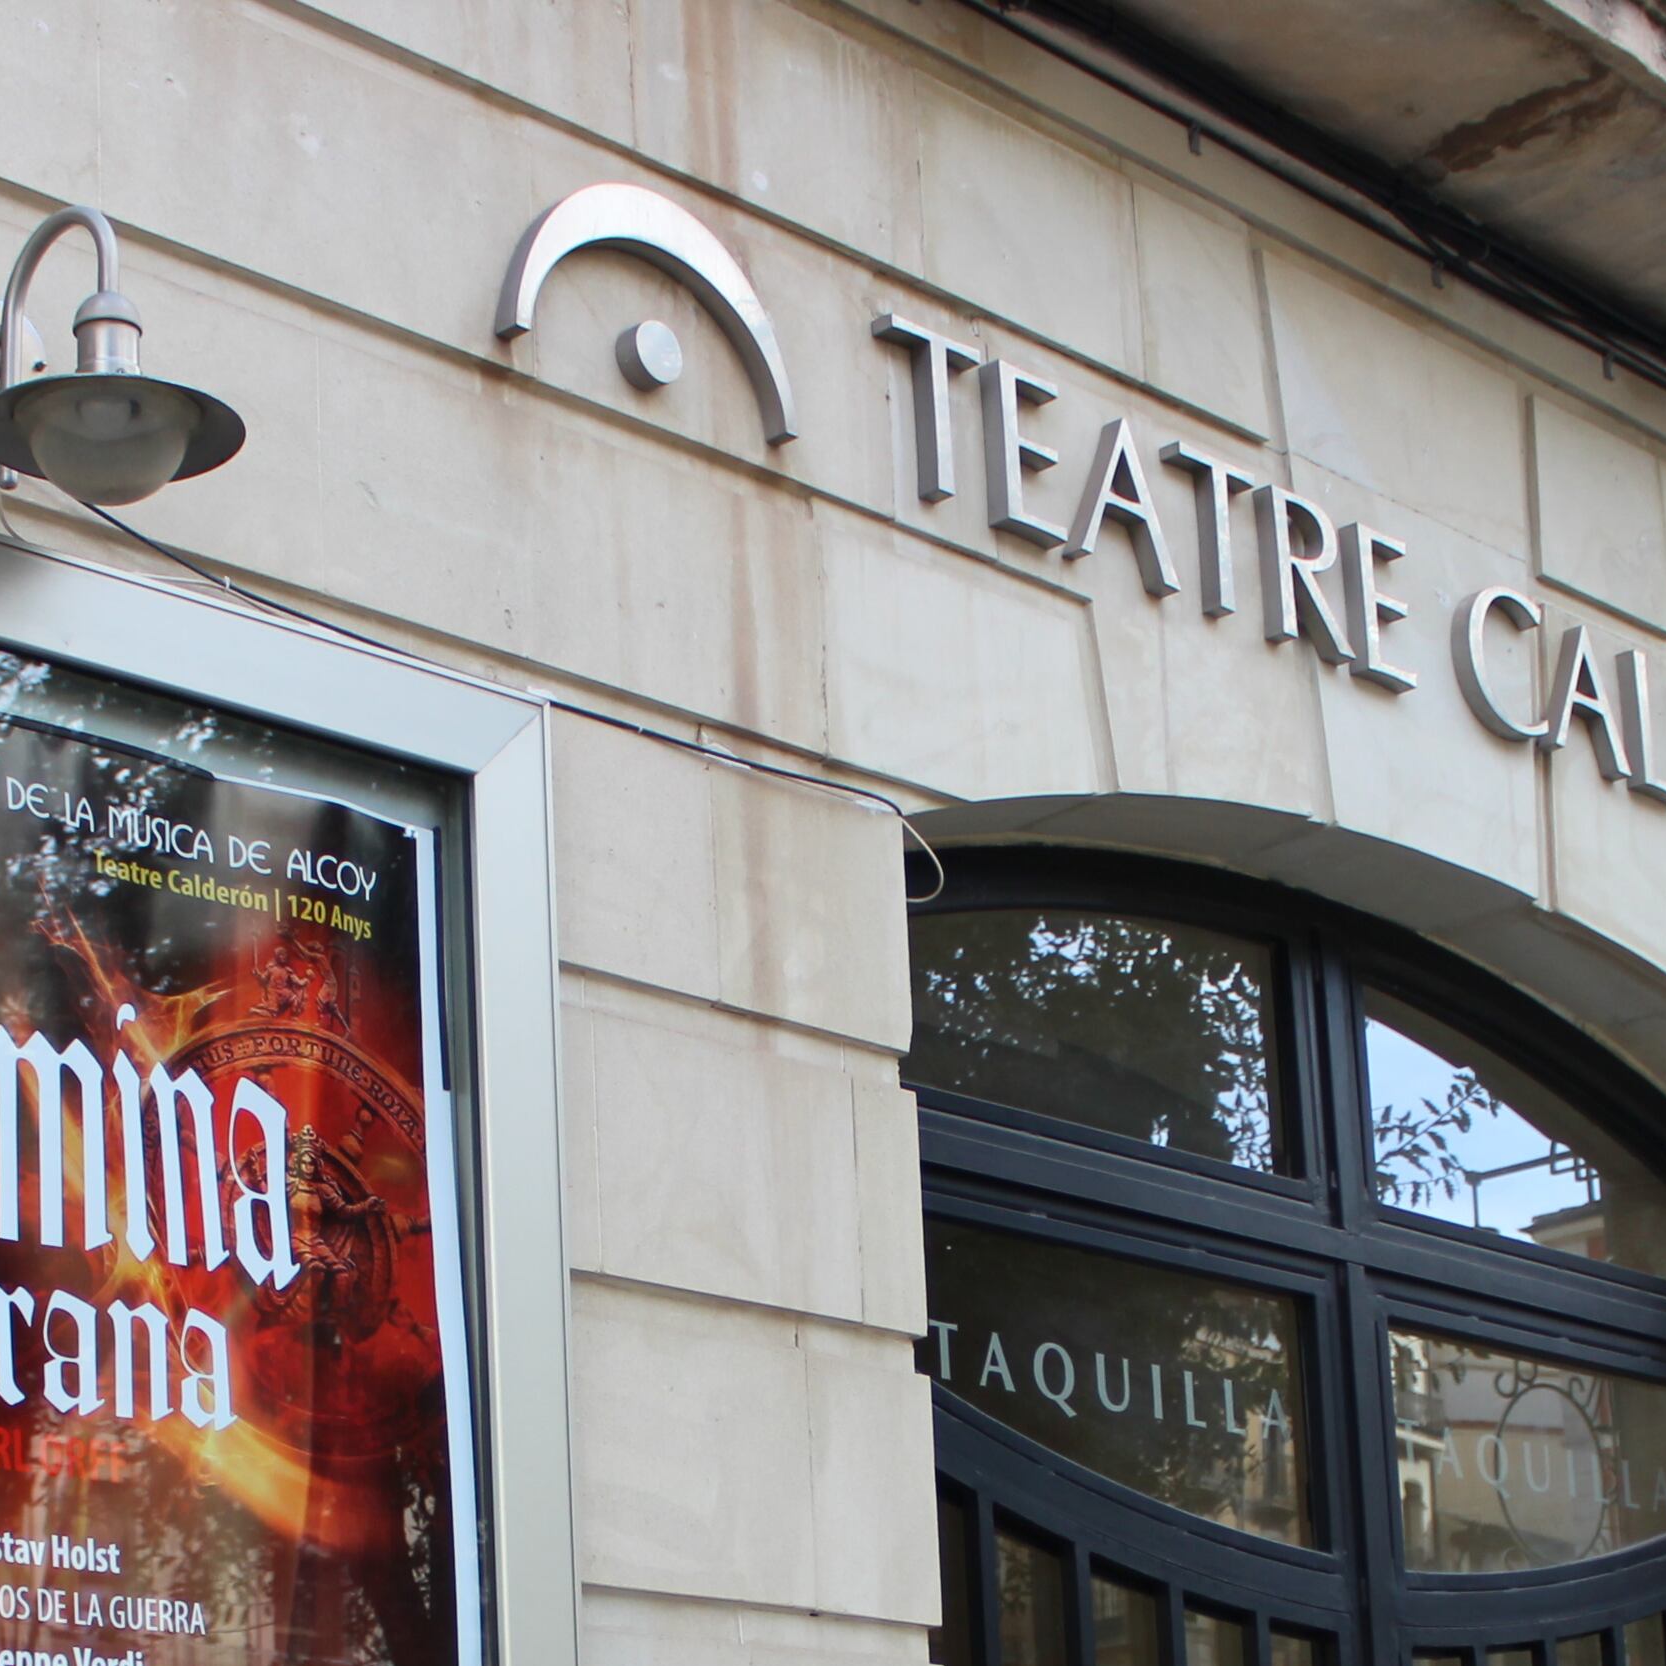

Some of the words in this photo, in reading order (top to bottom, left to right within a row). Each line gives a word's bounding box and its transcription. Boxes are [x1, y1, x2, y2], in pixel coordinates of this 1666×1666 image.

[871, 311, 1418, 695] TEATRE
[7, 776, 50, 820] DE
[65, 792, 95, 833] LA
[108, 806, 214, 863] MÚSICA
[229, 835, 272, 875] DE
[287, 848, 376, 901] ALCOY
[94, 848, 162, 890] Teatre
[168, 869, 269, 913] Calderón
[287, 895, 327, 925] 120
[330, 904, 372, 940] Anys
[928, 1318, 1290, 1441] TAQUILLA
[43, 1433, 128, 1483] ORFF
[50, 1534, 121, 1575] Holst
[36, 1589, 68, 1625] DE
[73, 1592, 103, 1628] LA
[108, 1594, 206, 1636] GUERRA
